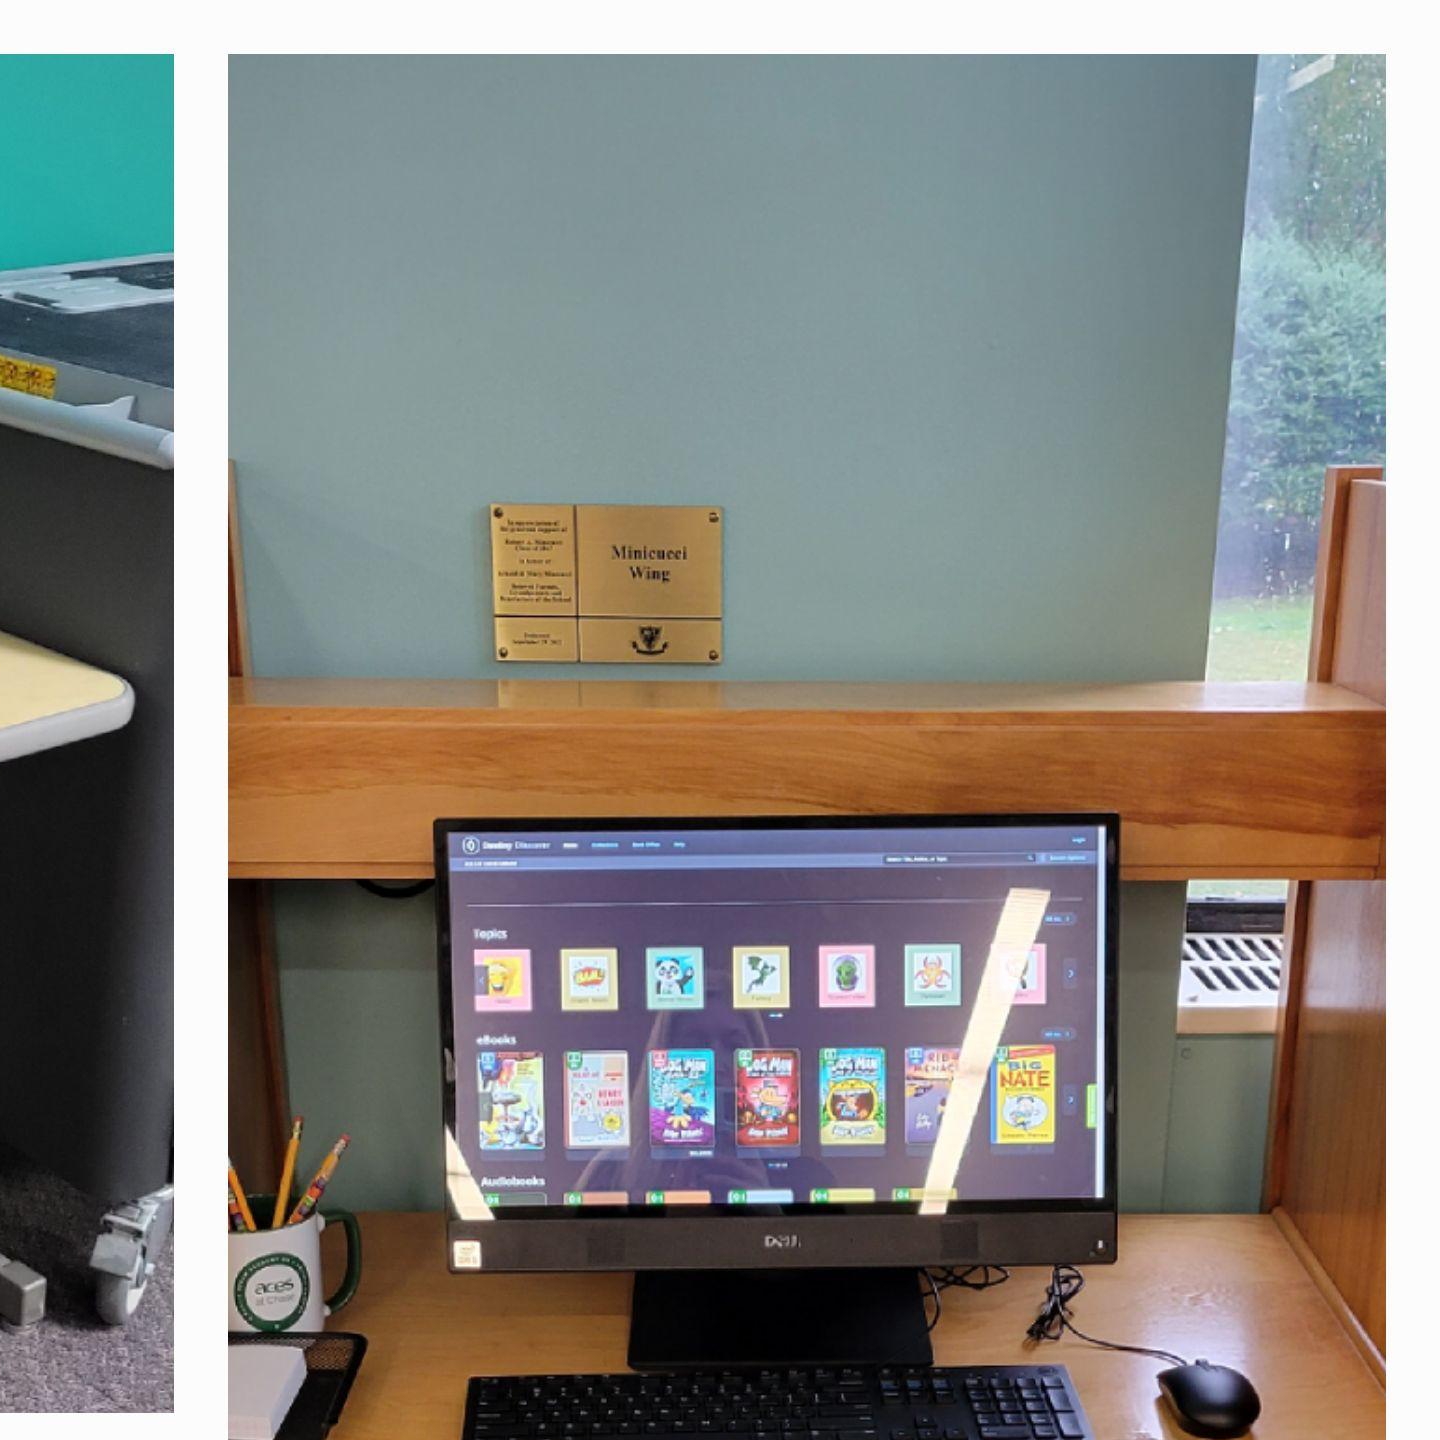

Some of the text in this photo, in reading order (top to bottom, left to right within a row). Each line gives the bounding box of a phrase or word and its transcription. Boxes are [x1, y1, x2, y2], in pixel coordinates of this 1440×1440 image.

[611, 545, 688, 560] Minicucci
[629, 566, 671, 584] Wing
[473, 928, 508, 940] Topics
[476, 1034, 517, 1046] eBooks
[1000, 1070, 1051, 1088] NATE
[481, 1176, 546, 1188] Audiobooks
[764, 1234, 801, 1248] DELL
[255, 1278, 294, 1295] aces
